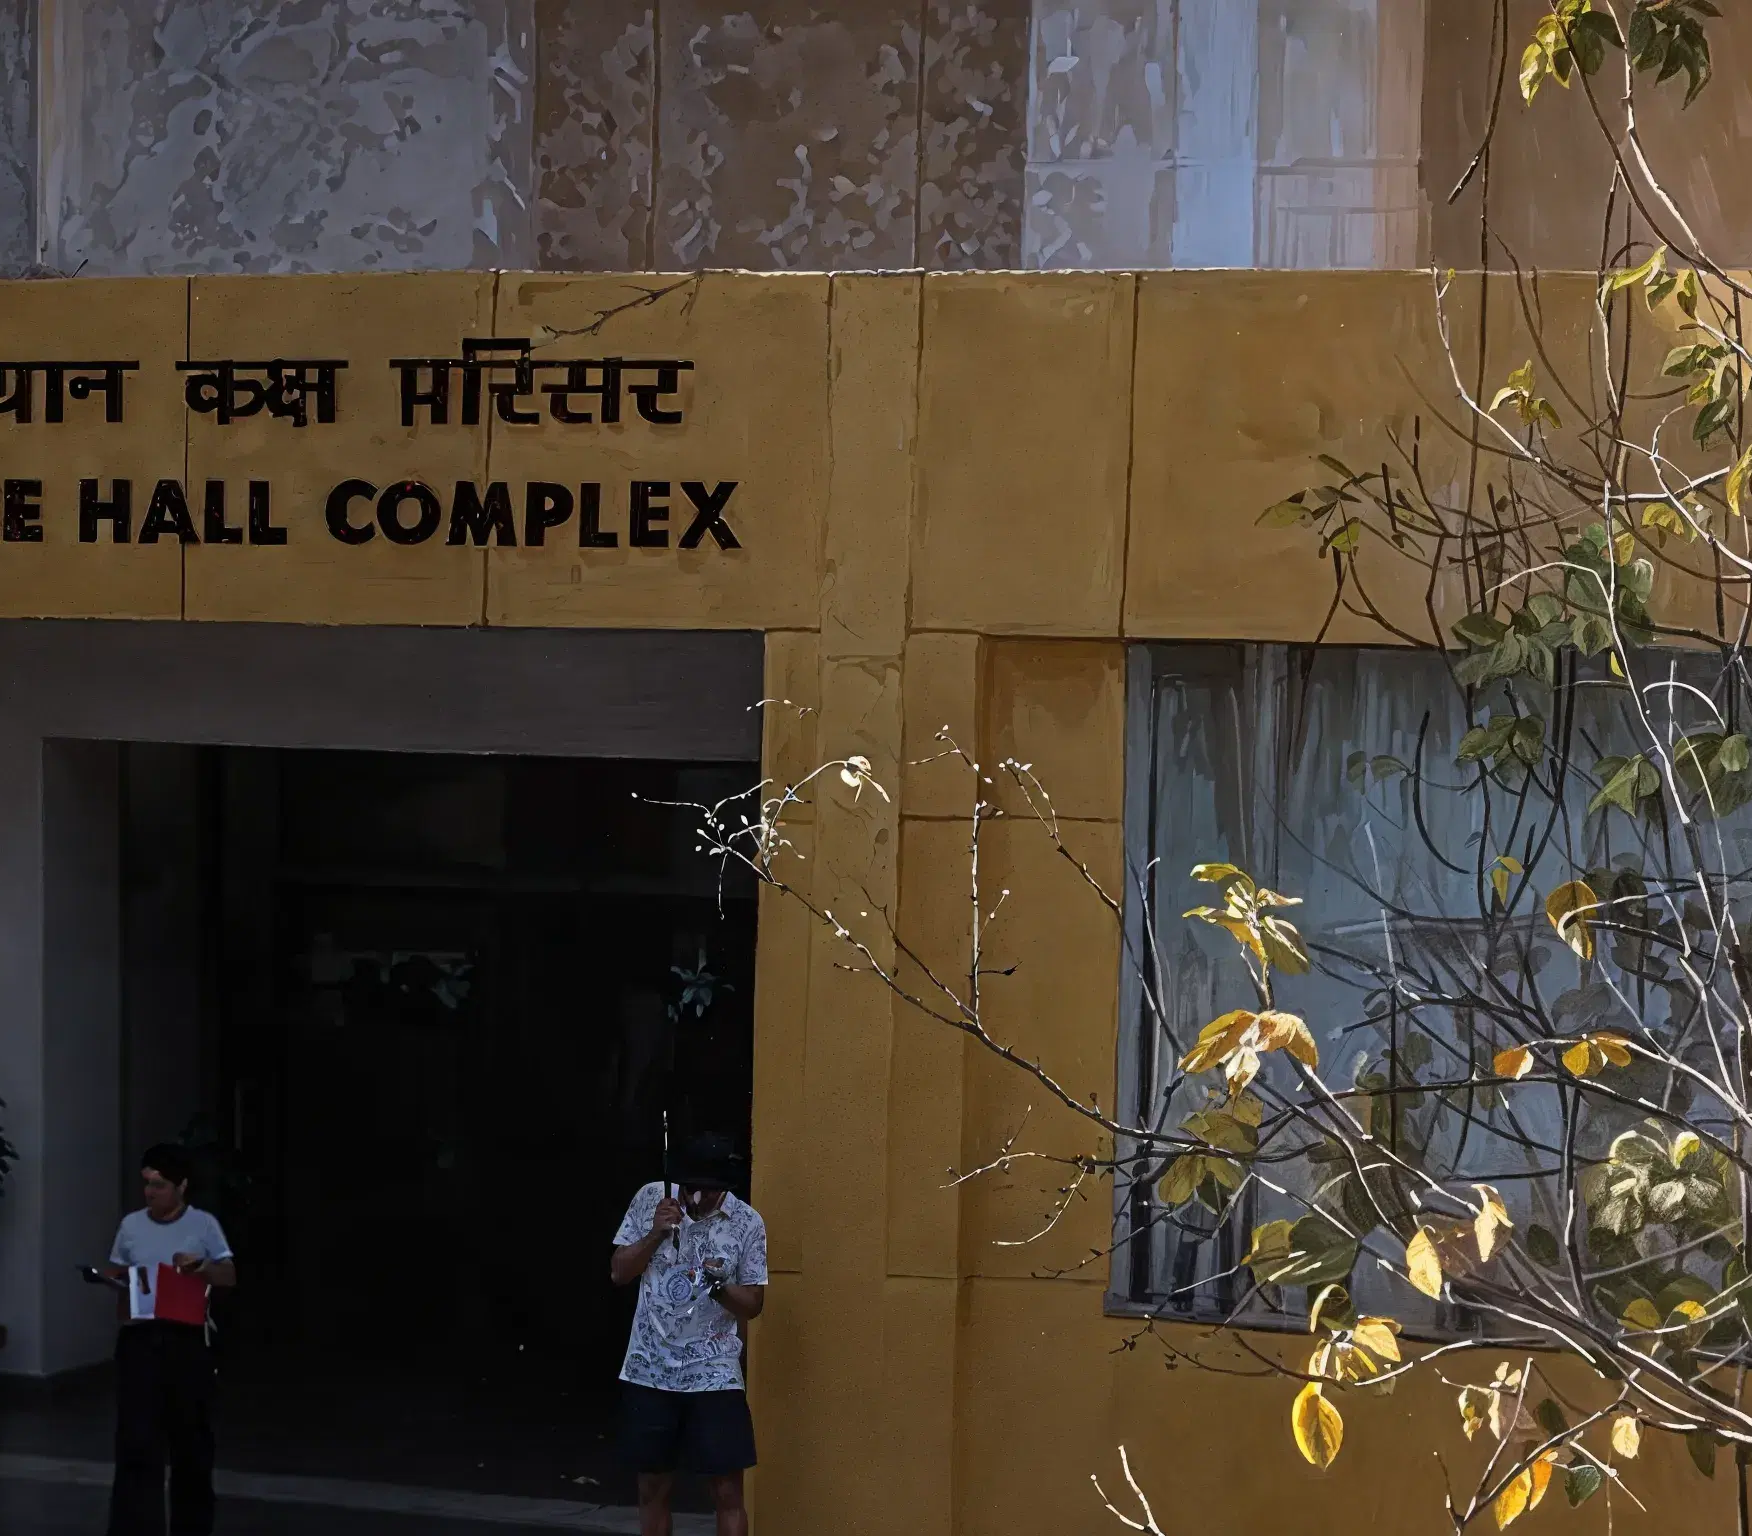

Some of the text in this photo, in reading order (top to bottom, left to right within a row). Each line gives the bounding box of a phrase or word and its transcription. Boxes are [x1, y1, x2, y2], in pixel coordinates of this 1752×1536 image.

[175, 358, 348, 427] कक्ष
[79, 479, 289, 546] HALL
[325, 478, 742, 549] COMPLEX
